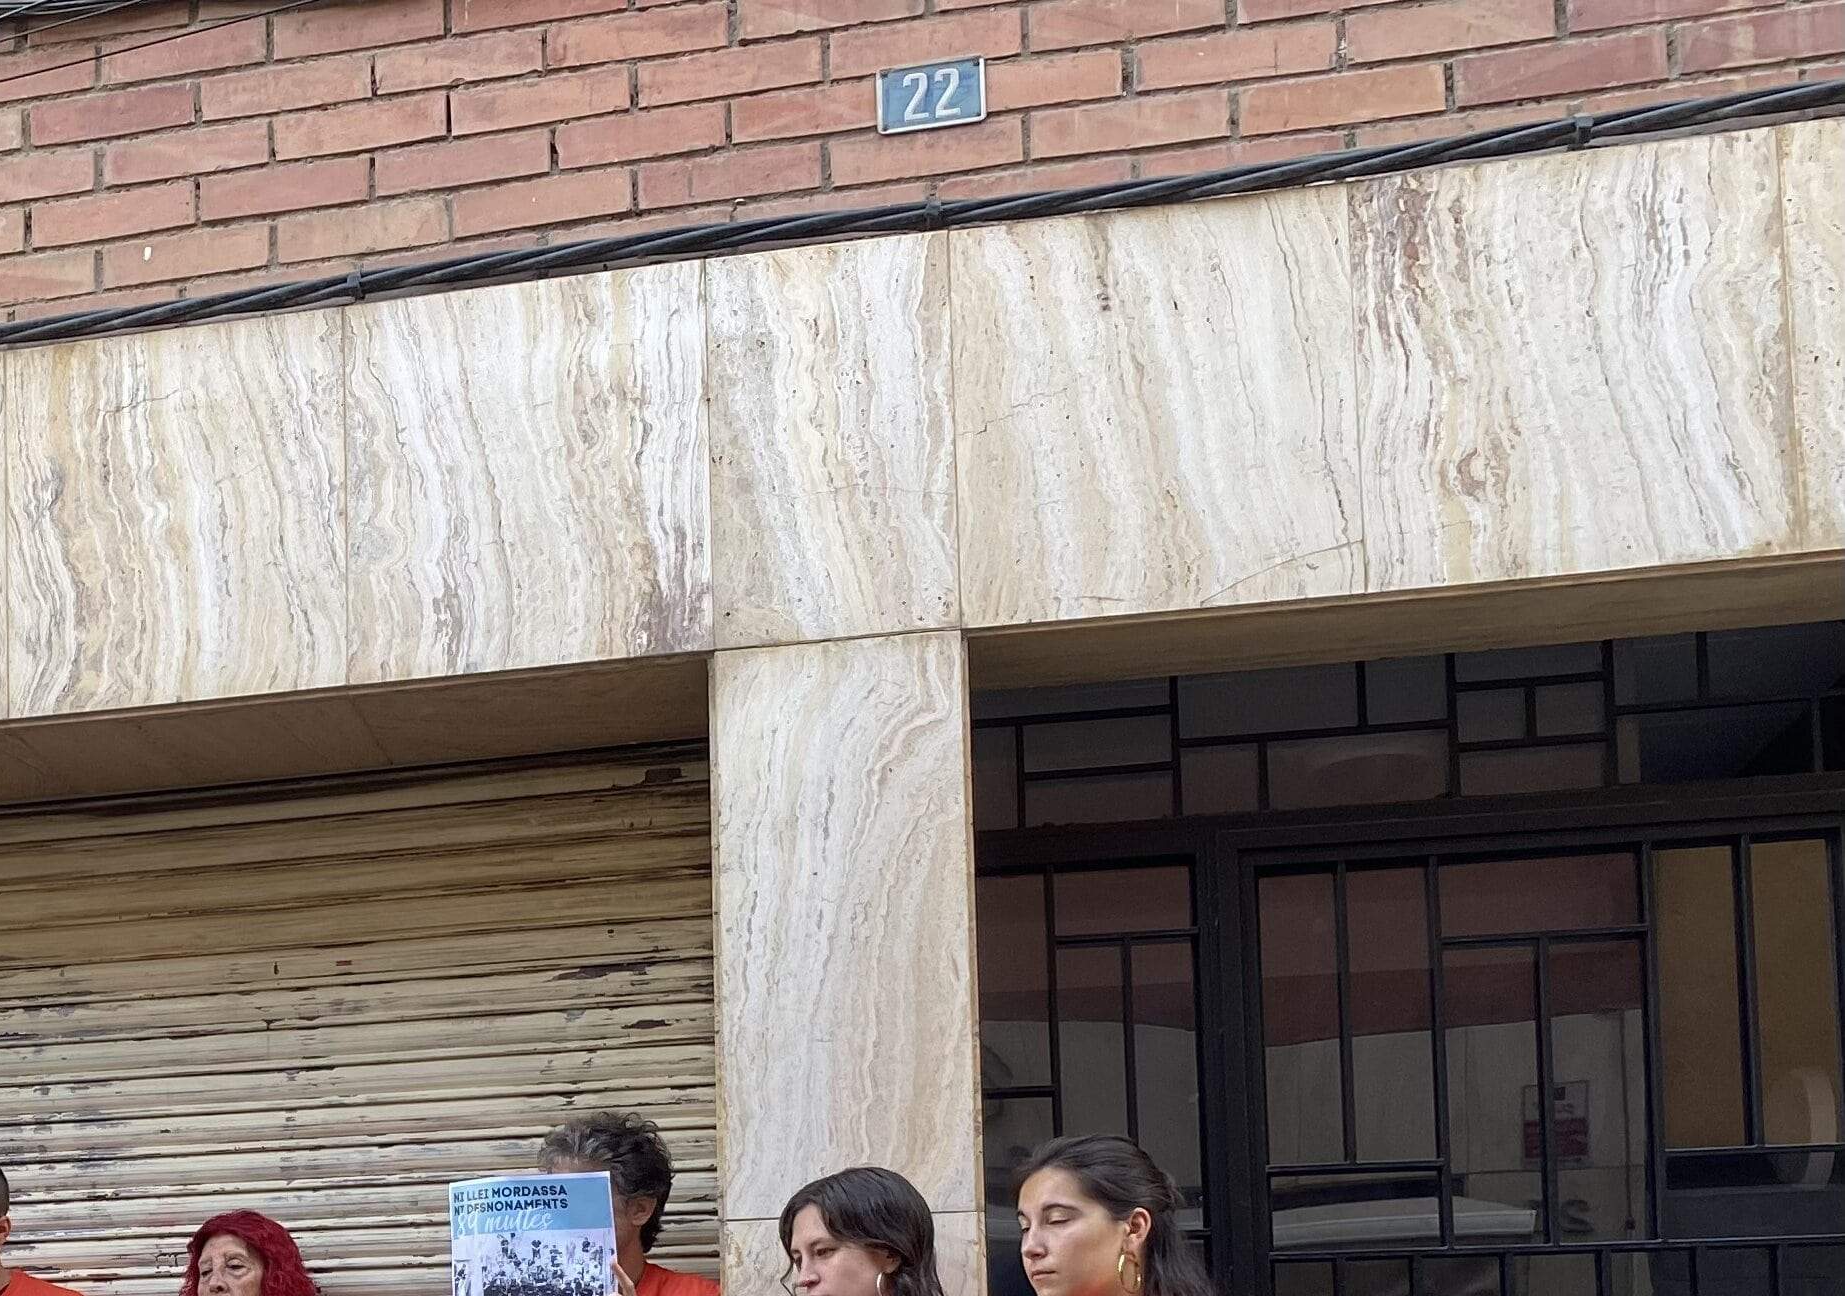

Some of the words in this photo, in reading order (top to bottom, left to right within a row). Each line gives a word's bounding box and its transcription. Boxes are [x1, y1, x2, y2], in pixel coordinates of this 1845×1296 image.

[902, 68, 962, 123] 22
[454, 1192, 465, 1203] NI
[466, 1189, 489, 1201] LLEI
[492, 1185, 568, 1198] MORDASSA
[467, 1199, 568, 1215] DESNONAMENTS
[456, 1212, 478, 1237] 89
